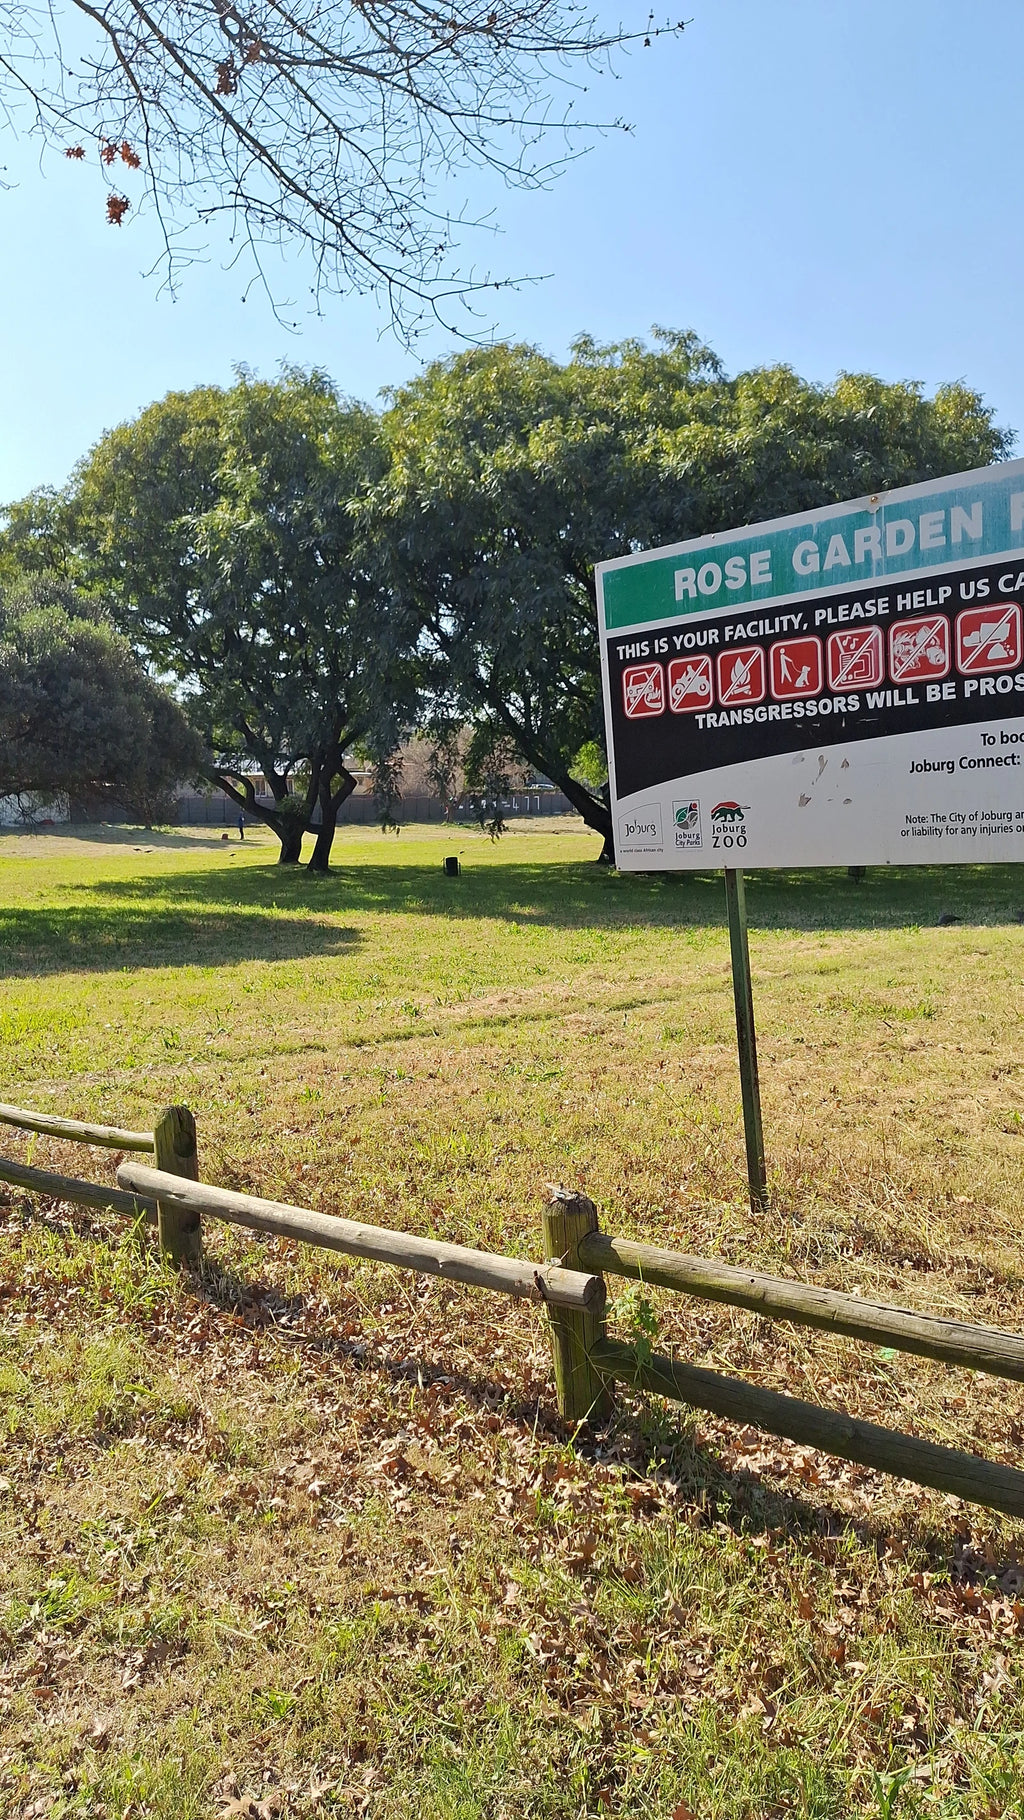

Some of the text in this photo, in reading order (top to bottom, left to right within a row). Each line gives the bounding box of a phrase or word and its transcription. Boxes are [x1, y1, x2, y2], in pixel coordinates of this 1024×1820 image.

[674, 550, 772, 600] ROSE
[792, 502, 983, 575] GARDEN
[616, 641, 650, 660] THIS
[654, 637, 669, 654] IS
[673, 628, 720, 650] YOUR
[724, 612, 809, 642] FACILITY,
[814, 597, 890, 626] PLEASE
[897, 585, 952, 612] HELP
[959, 578, 990, 600] US
[694, 694, 860, 729] TRANSGRESSORS
[865, 687, 919, 709] WILL
[926, 682, 957, 702] BE
[980, 732, 996, 746] To
[909, 752, 1021, 774] Joburg Connect:
[905, 814, 929, 825] Note:
[930, 813, 947, 823] The
[949, 811, 967, 824] City
[968, 810, 979, 821] of
[980, 810, 1013, 822] Joburg
[625, 819, 657, 837] Joburg
[712, 824, 746, 835] Joburg
[900, 829, 910, 837] or
[911, 826, 944, 838] liability
[945, 825, 959, 835] for
[960, 826, 978, 837] any
[979, 823, 1014, 836] injuries
[675, 832, 701, 841] Joburg
[675, 839, 701, 848] City Parks
[711, 834, 748, 848] ZOO
